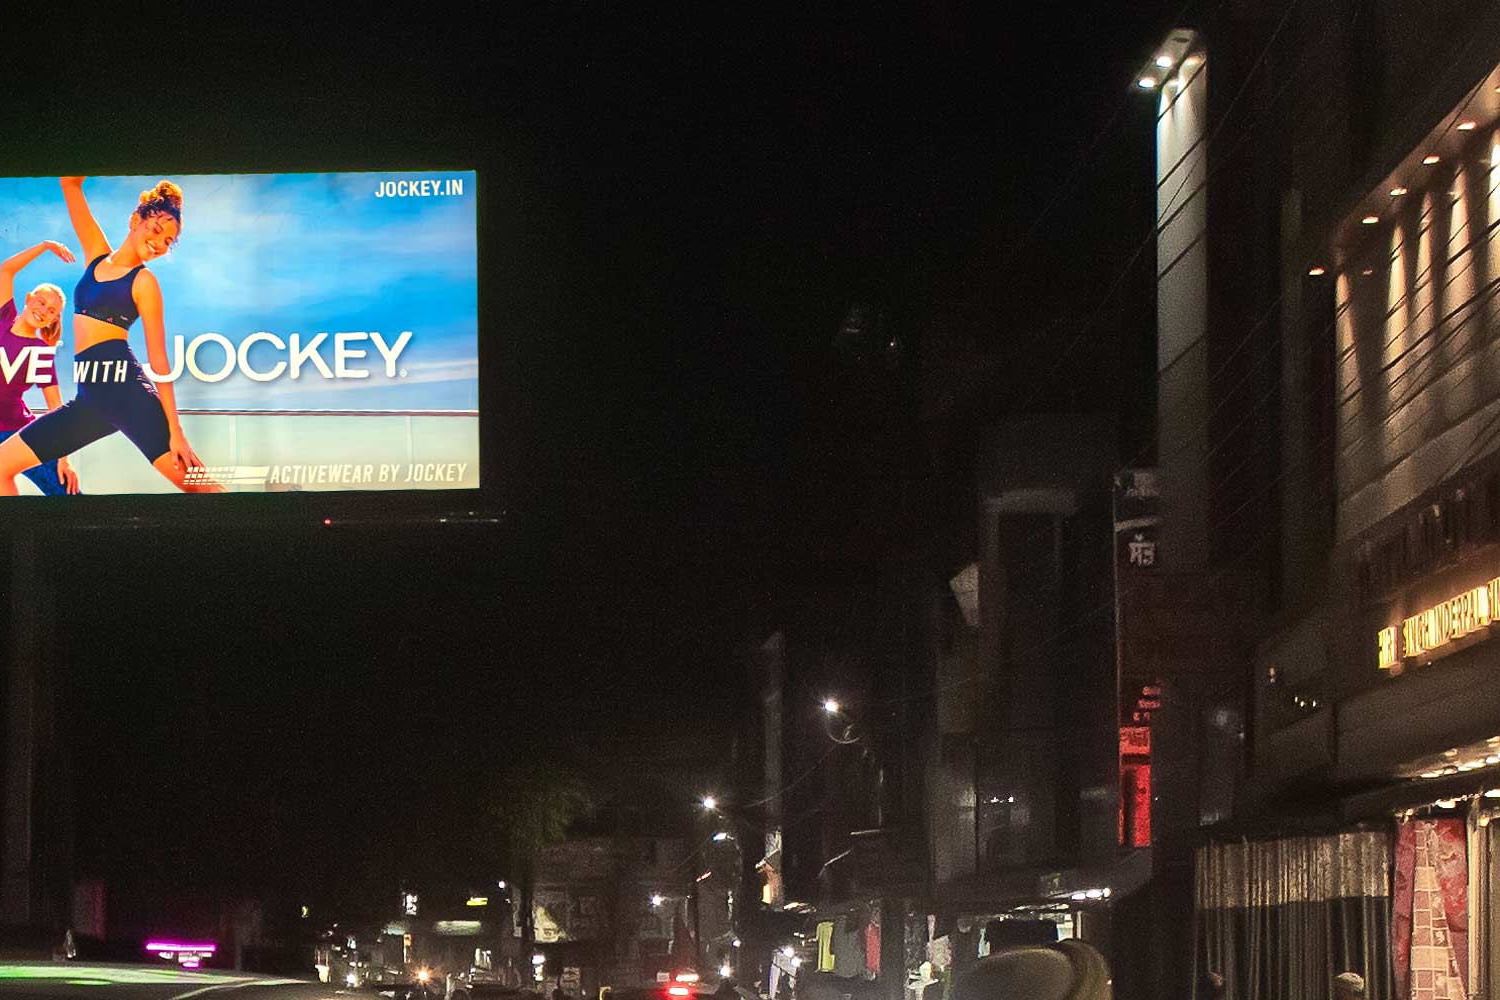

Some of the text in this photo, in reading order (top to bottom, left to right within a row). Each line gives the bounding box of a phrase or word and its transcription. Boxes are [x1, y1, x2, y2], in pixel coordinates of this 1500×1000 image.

[374, 179, 463, 198] JOCKEY.IN
[73, 360, 128, 383] WITH
[141, 331, 413, 383] JOCKEY
[269, 463, 468, 484] ACTIVEWEAR BY JOCKEY
